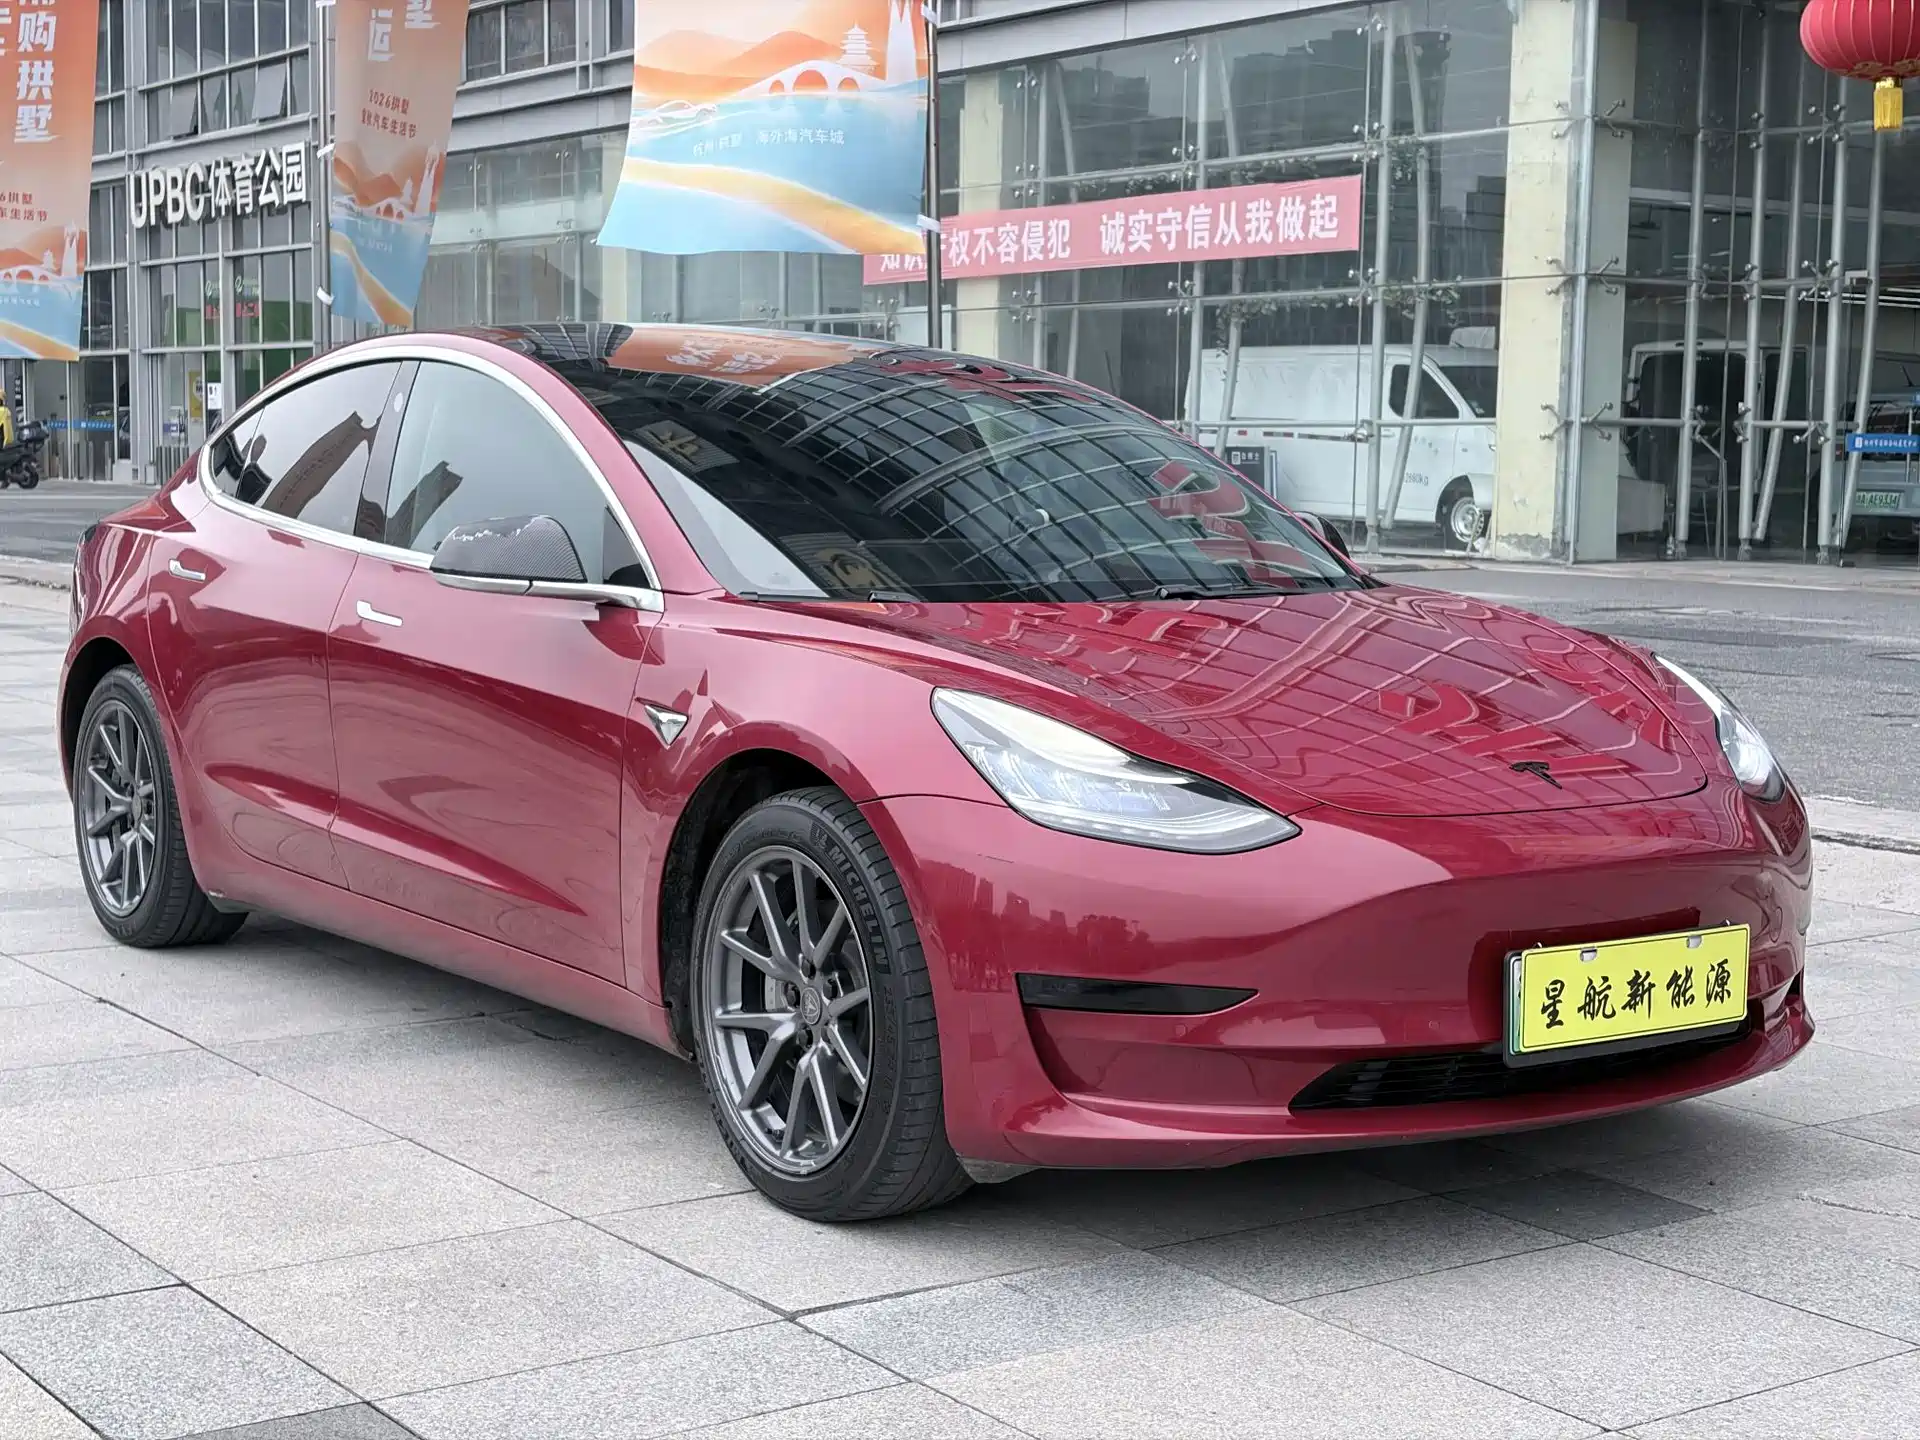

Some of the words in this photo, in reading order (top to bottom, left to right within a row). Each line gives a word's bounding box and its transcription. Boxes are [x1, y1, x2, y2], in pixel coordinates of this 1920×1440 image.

[1100, 192, 1338, 254] 诚实守信从我做起
[828, 844, 890, 975] MICHELIN
[1540, 958, 1732, 1029] 星航新能源
